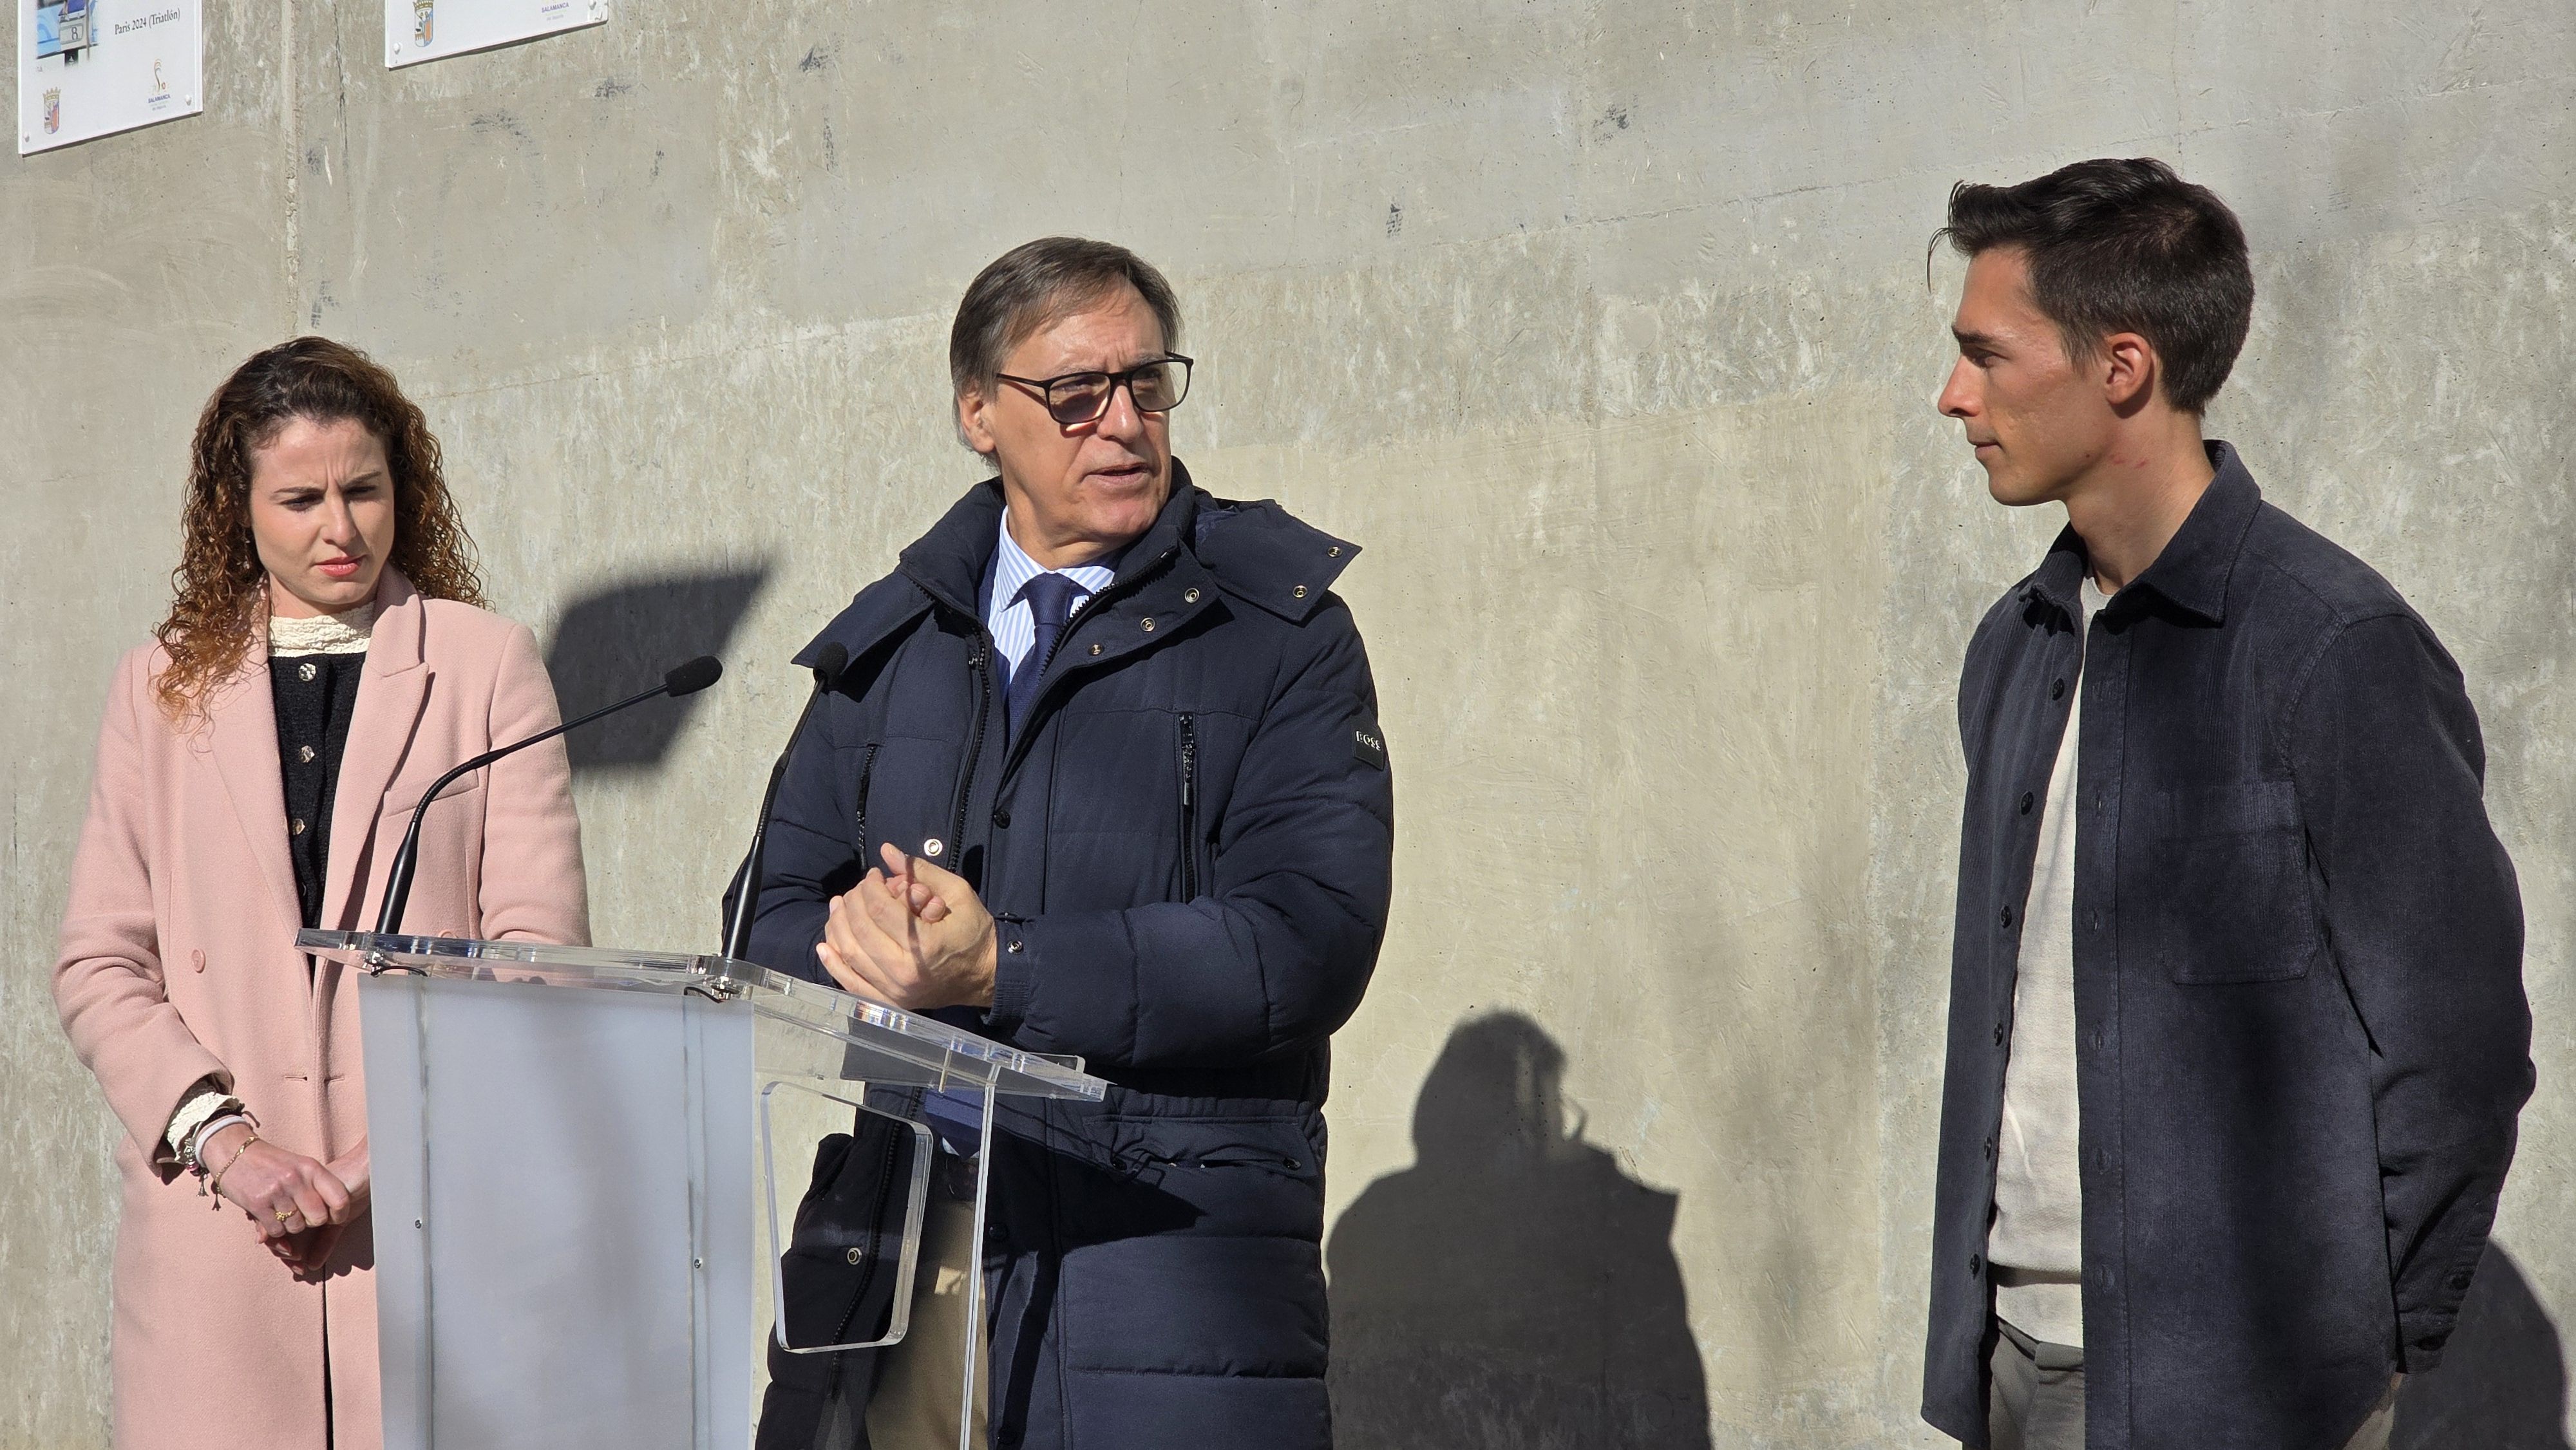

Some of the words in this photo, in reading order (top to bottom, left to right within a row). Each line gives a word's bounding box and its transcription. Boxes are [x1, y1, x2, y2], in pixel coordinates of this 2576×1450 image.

[542, 2, 569, 13] SALAMANCA
[115, 21, 131, 35] Paris
[131, 17, 147, 30] 2024
[149, 8, 180, 28] (Triatlón)
[71, 26, 79, 41] 8
[148, 94, 171, 103] SALAMANCA
[1356, 731, 1381, 751] BOSS
